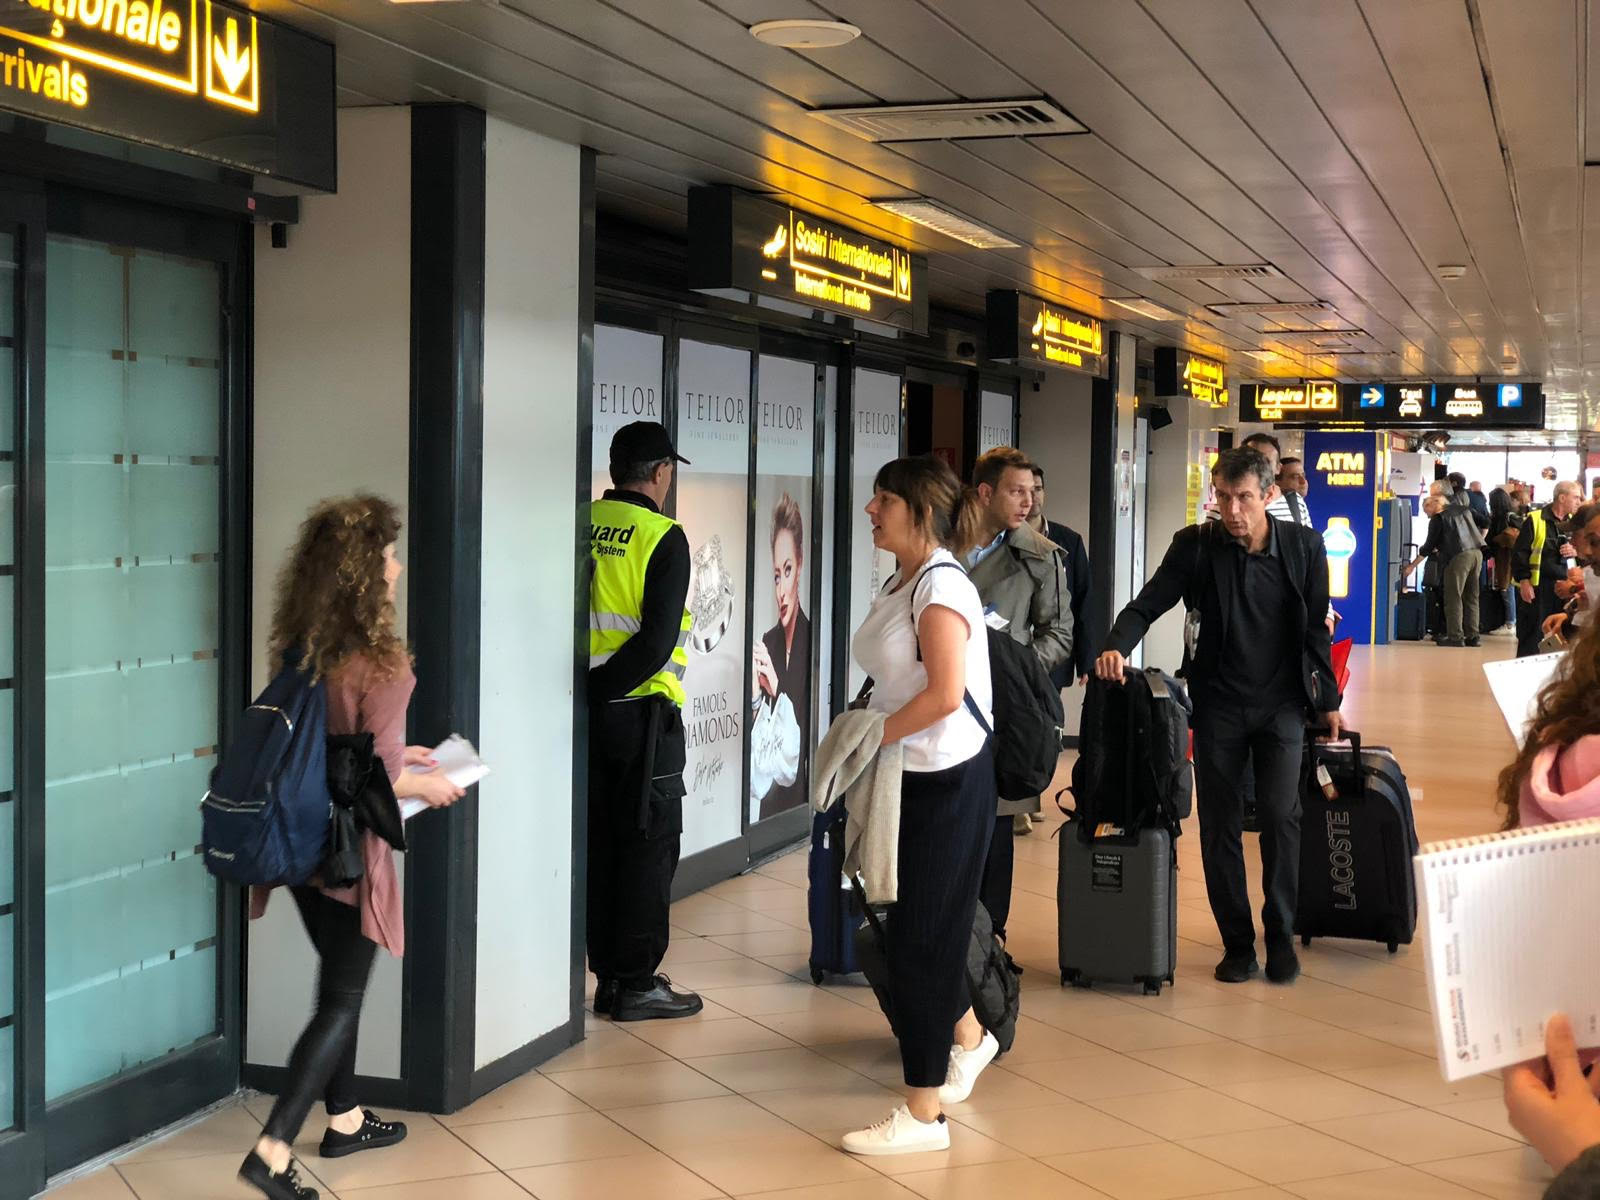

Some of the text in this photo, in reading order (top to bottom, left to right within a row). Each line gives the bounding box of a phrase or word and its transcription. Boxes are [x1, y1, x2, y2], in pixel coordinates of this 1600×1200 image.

[0, 48, 88, 107] rivals
[795, 220, 827, 258] Sosiri
[592, 383, 656, 417] EILOR
[686, 392, 744, 424] TEILOR
[1399, 385, 1519, 407] Taxi Bus P
[858, 411, 896, 436] TEILOR
[983, 425, 1010, 447] TEILOR
[1316, 452, 1365, 471] ATM
[1327, 473, 1365, 486] HERE
[596, 542, 626, 558] System
[693, 691, 727, 718] FAMOUS
[1326, 810, 1357, 910] LACOSTE
